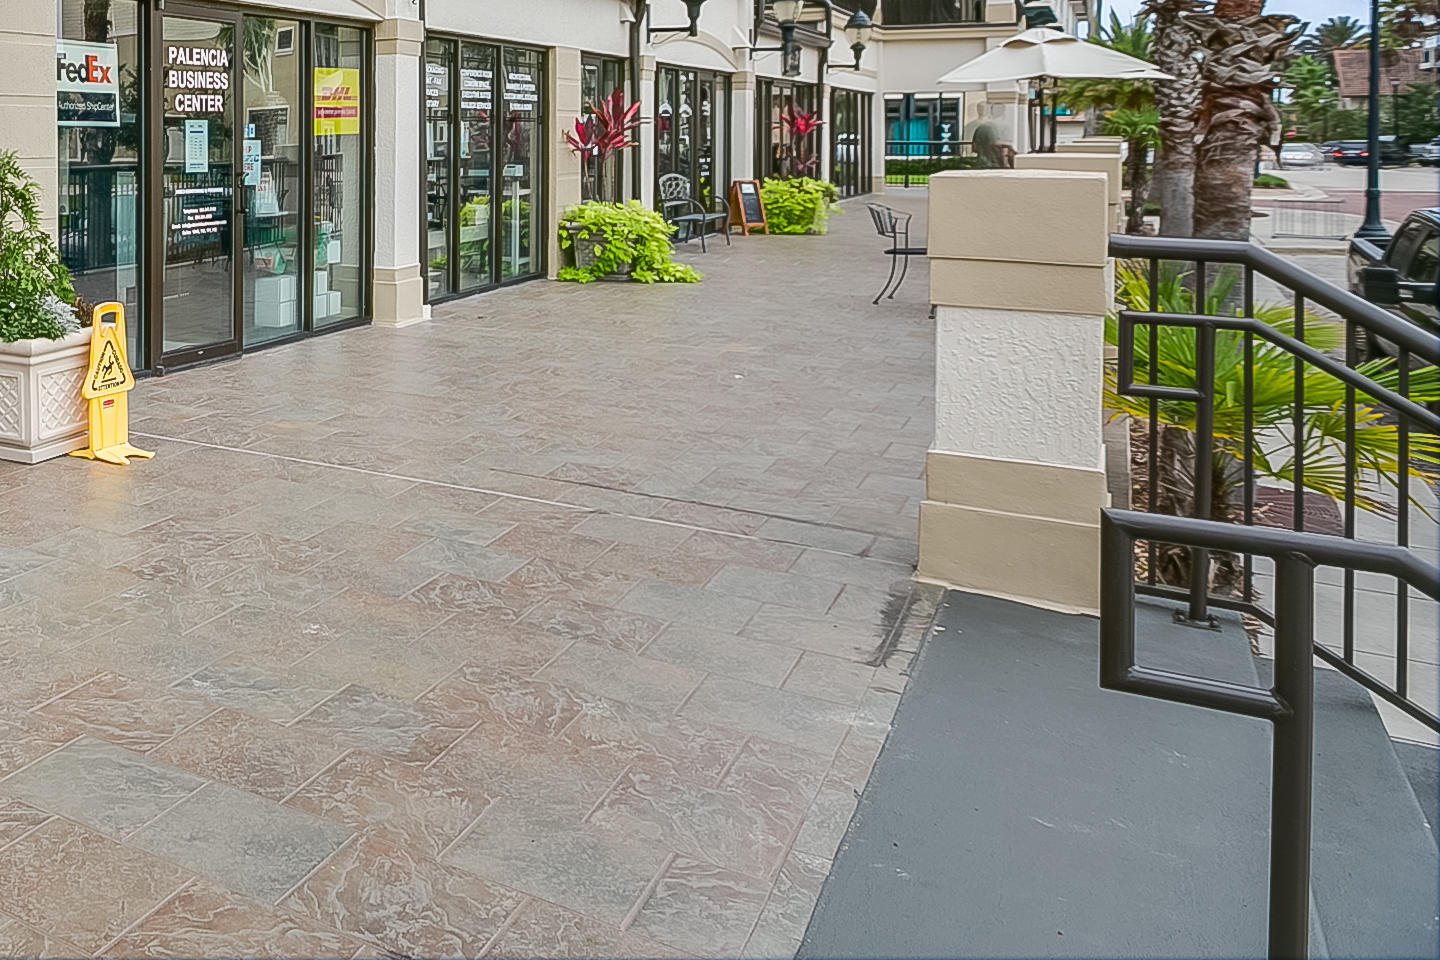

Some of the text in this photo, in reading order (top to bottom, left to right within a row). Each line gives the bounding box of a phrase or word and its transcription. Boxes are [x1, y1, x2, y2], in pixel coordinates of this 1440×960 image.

[168, 46, 229, 68] PALENCIA
[57, 52, 112, 84] FedEx
[168, 70, 229, 90] BUSINESS
[174, 94, 224, 112] CENTER
